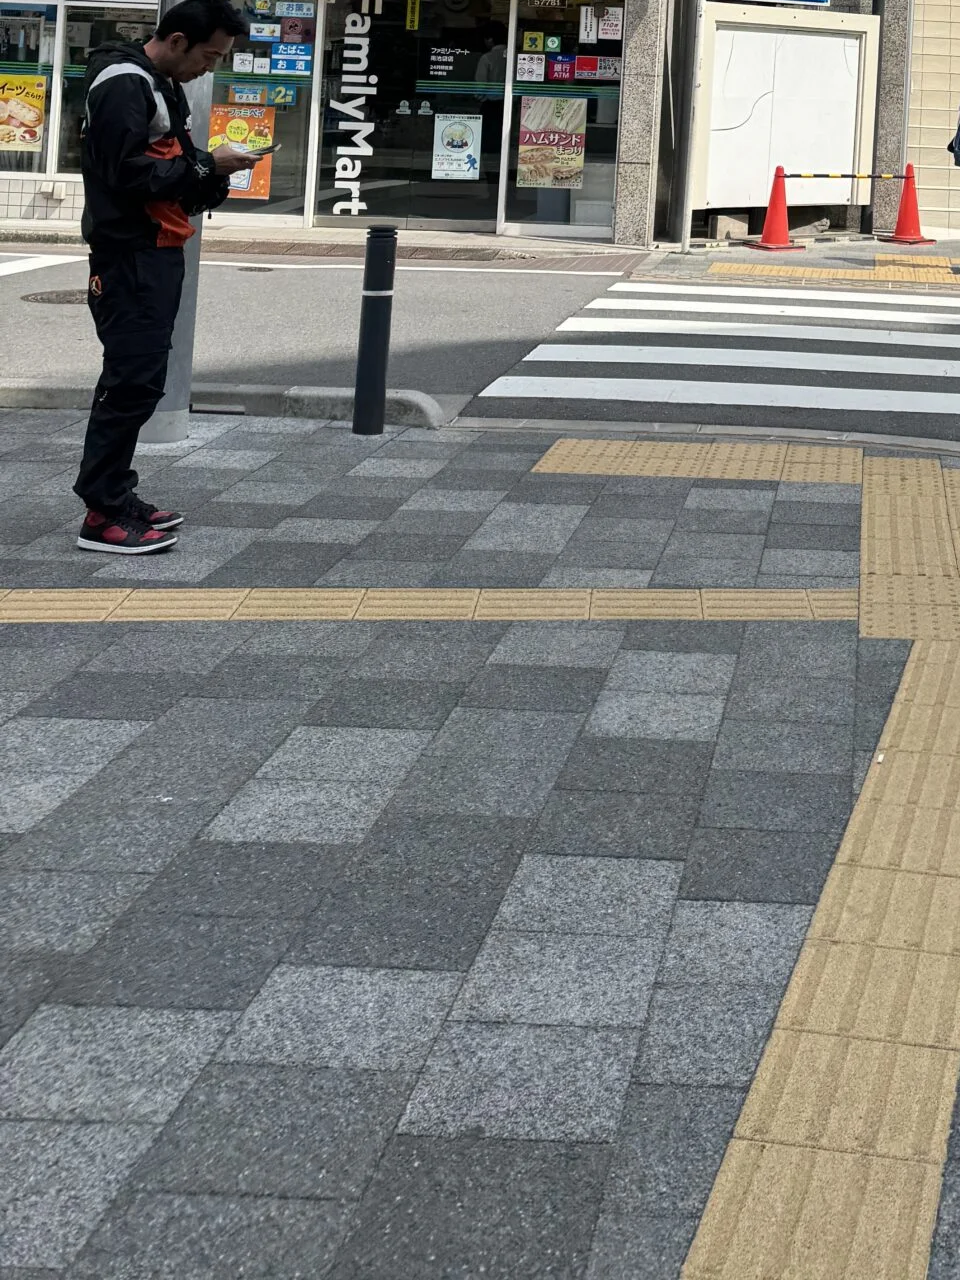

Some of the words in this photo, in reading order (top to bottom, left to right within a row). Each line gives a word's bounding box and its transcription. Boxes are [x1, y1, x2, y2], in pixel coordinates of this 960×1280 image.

[278, 44, 305, 55] たばこ
[431, 47, 470, 56] ファミリーマート
[553, 63, 570, 72] 銀行
[228, 107, 265, 118] ファミペイ
[524, 133, 581, 146] ハムサンド
[556, 146, 583, 156] まつり
